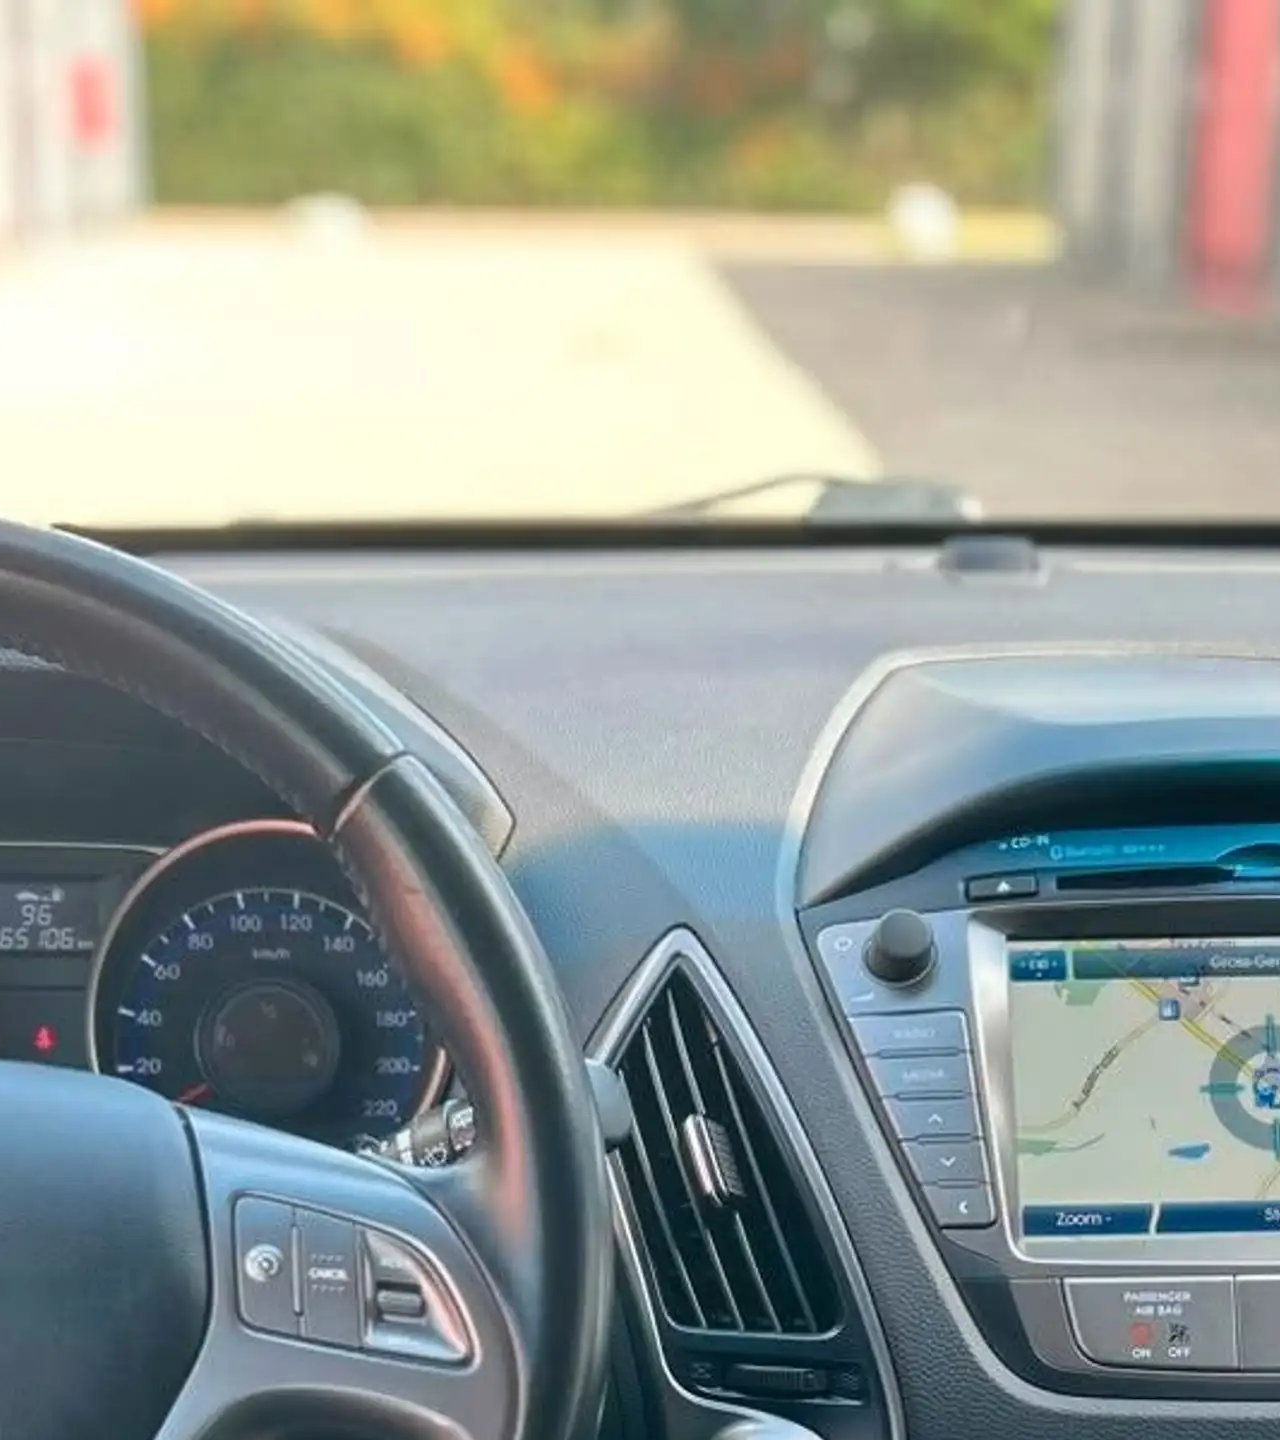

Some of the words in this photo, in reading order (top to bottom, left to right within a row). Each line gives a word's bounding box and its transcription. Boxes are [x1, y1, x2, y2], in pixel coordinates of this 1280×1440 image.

[20, 903, 53, 927] 96
[230, 914, 262, 932] 100
[280, 914, 312, 932] 120
[187, 934, 214, 950] 80
[323, 936, 354, 953] 140
[154, 964, 181, 980] 60
[356, 969, 388, 987] 160
[136, 1010, 162, 1027] 40
[376, 1010, 407, 1028] 180
[135, 1057, 162, 1074] 20
[376, 1057, 409, 1074] 200
[364, 1100, 398, 1117] 220
[1055, 1212, 1103, 1227] Zoom
[1123, 1290, 1192, 1303] PASSENGER
[1131, 1346, 1152, 1359] ON
[1167, 1346, 1192, 1359] OFF
